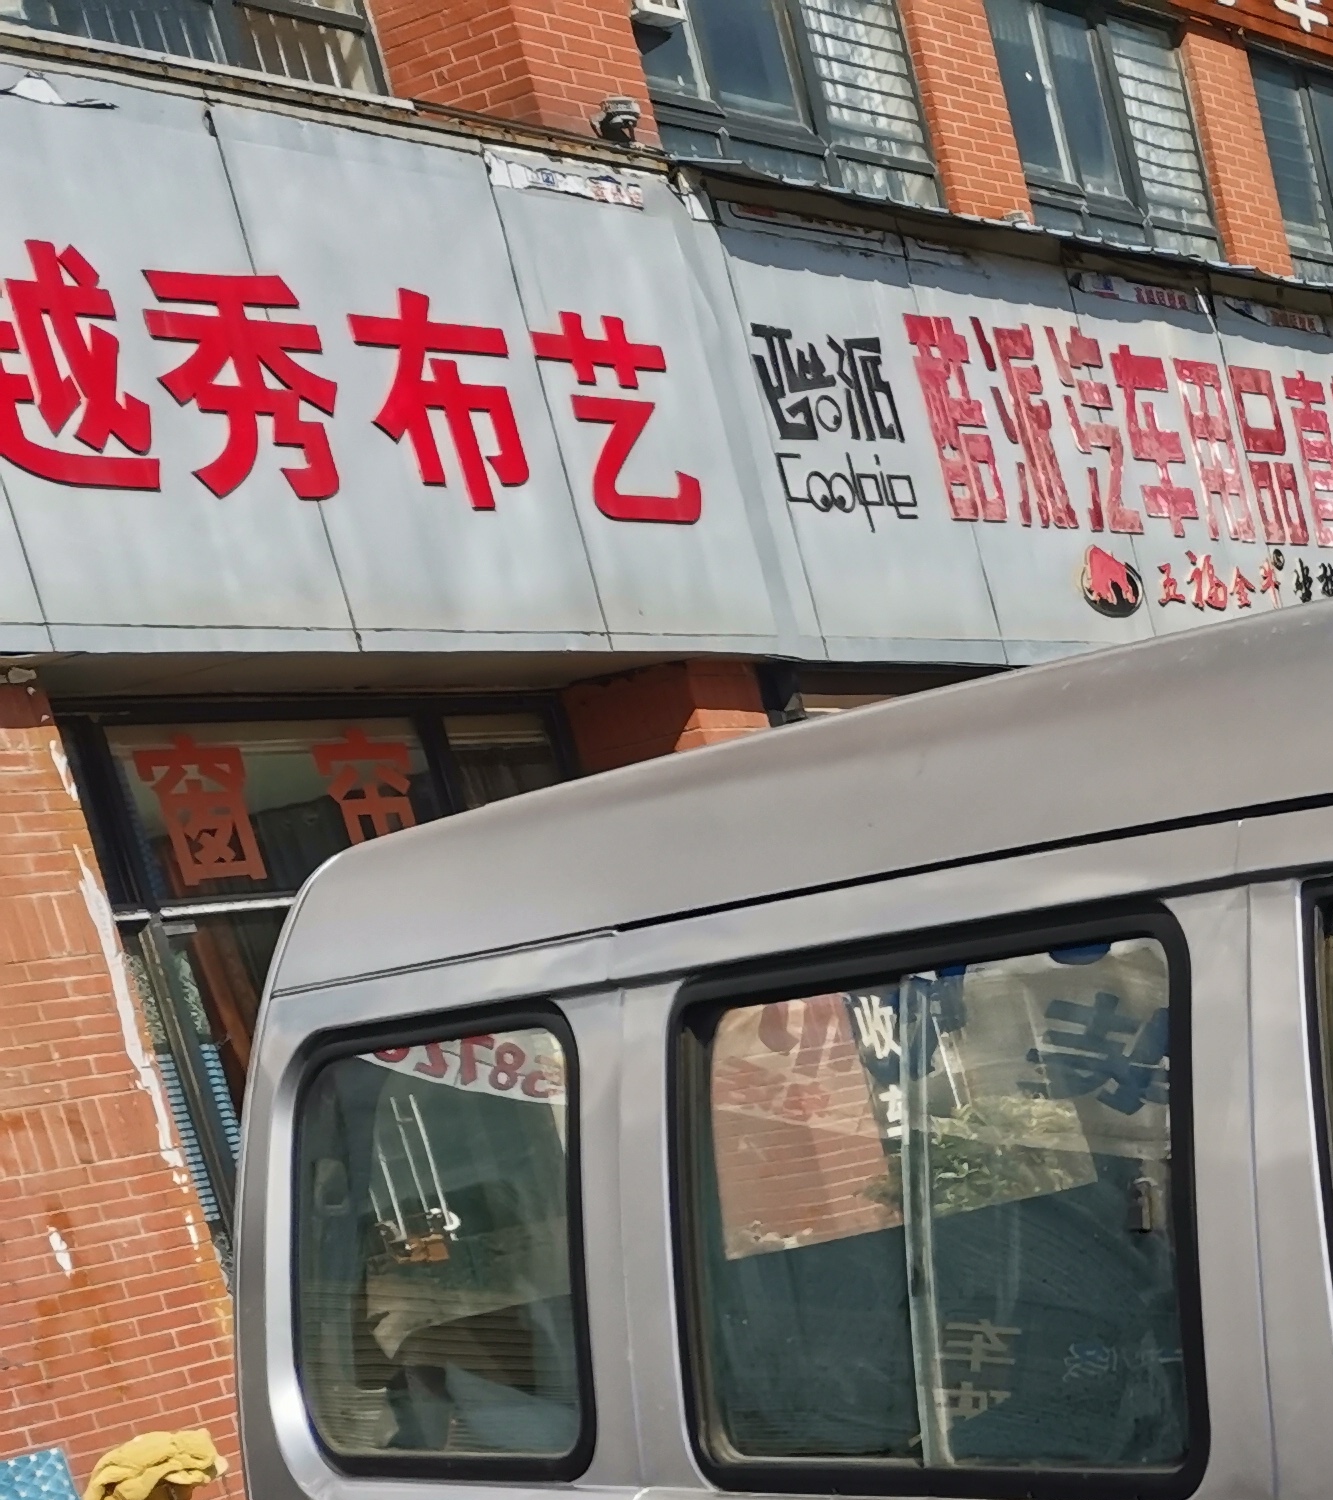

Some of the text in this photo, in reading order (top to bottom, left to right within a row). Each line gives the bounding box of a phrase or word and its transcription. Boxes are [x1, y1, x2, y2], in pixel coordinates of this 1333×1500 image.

[0, 239, 702, 525] 越秀布艺
[132, 726, 417, 887] 窗帘
